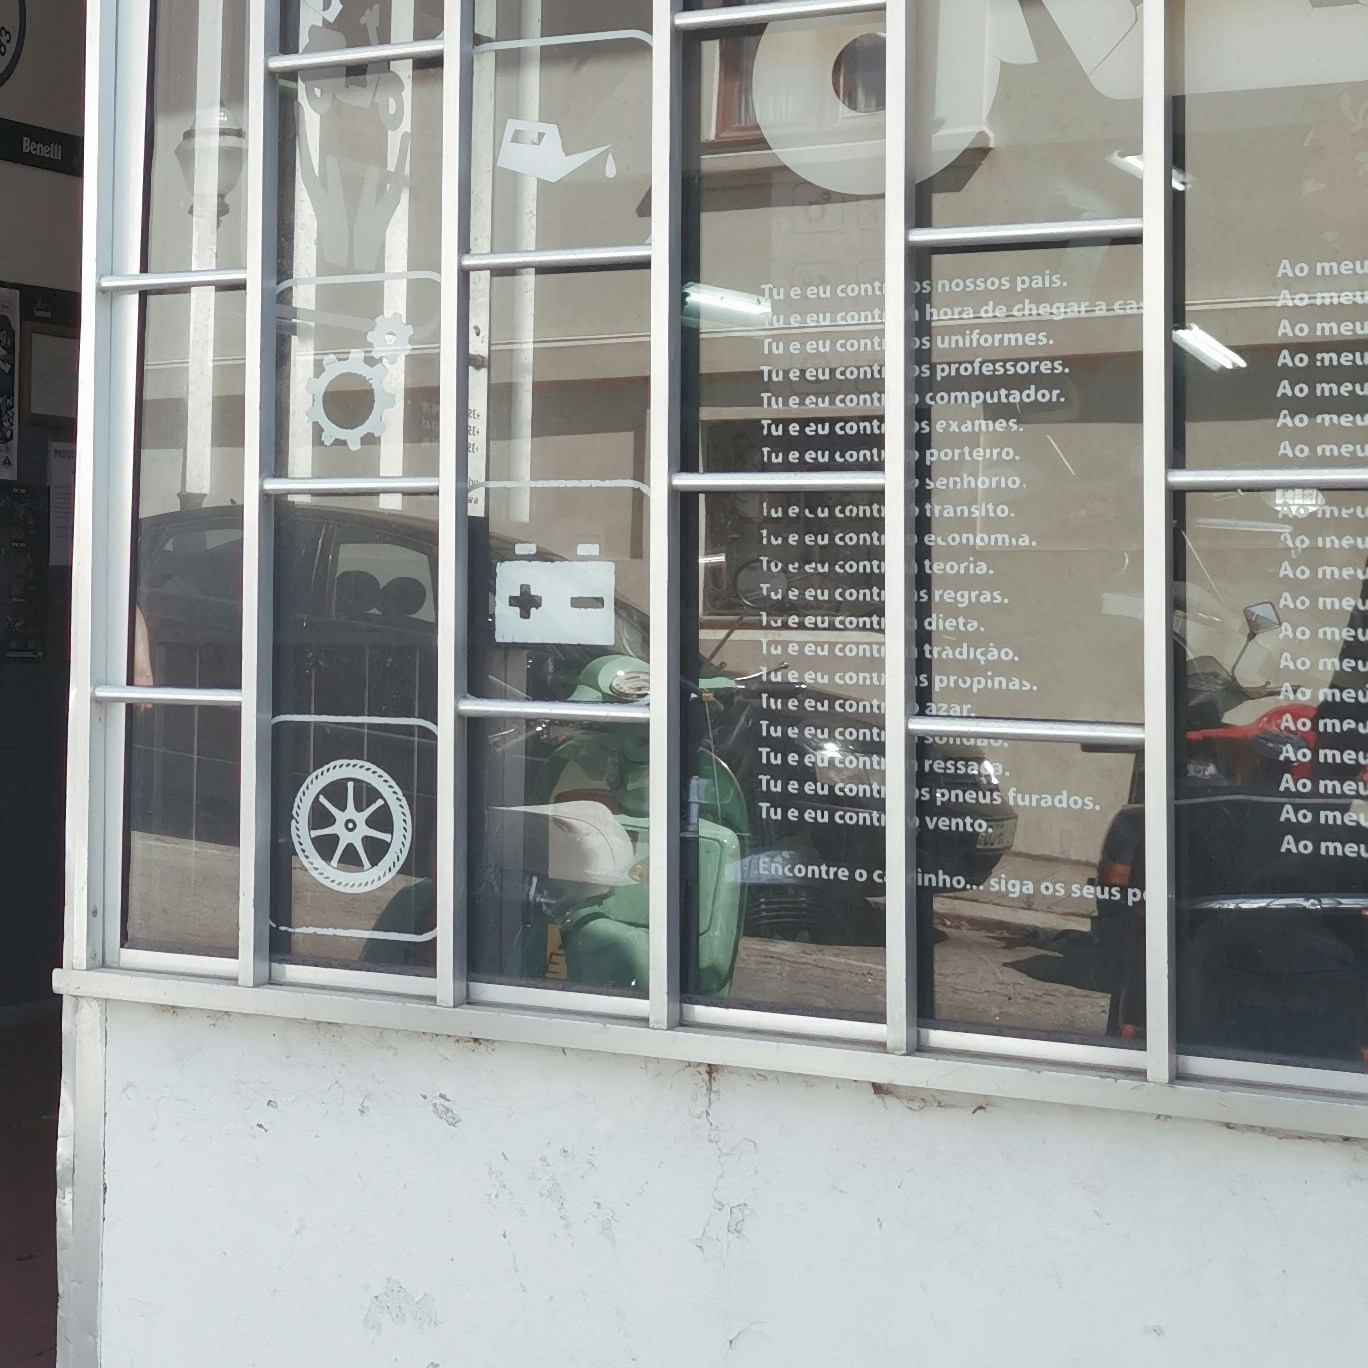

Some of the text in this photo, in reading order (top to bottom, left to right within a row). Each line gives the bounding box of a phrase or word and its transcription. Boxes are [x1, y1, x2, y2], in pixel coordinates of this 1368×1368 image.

[22, 135, 62, 161] Benelli
[1276, 259, 1309, 277] Ao
[761, 283, 783, 300] Tu
[790, 286, 801, 299] e
[807, 284, 830, 298] eu
[937, 275, 1010, 293] nossos
[1016, 270, 1068, 292] pais.
[929, 303, 974, 321] hora
[980, 301, 1006, 317] de
[1013, 299, 1089, 320] chegar
[1277, 319, 1309, 337] Ao
[763, 338, 783, 354] Tu
[789, 340, 800, 354] e
[806, 339, 830, 353] eu
[936, 330, 1054, 349] uniformes.
[1277, 349, 1309, 367] Ao
[760, 365, 783, 382] Tu
[789, 368, 800, 382] e
[805, 367, 830, 381] eu
[936, 360, 1070, 380] professores.
[760, 384, 1065, 408] Tu e eu computador.
[1276, 379, 1308, 398] Ao
[761, 418, 1024, 436] Tu e eu exames.
[762, 446, 1021, 466] Tu e eu porteiro.
[1278, 440, 1309, 458] Ao
[924, 557, 994, 575] teoria.
[760, 584, 1009, 608] Tu e eu regras.
[1278, 591, 1310, 609] Ao
[924, 613, 985, 632] dieta.
[1279, 622, 1310, 640] Ao
[788, 641, 799, 656] e
[804, 642, 829, 656] eu
[924, 642, 1019, 665] tradição.
[1279, 652, 1311, 671] Ao
[934, 672, 1038, 693] propinas.
[925, 702, 976, 717] azar.
[760, 721, 781, 738] Tu
[788, 724, 798, 738] e
[804, 725, 829, 739] eu
[759, 748, 781, 765] Tu
[787, 751, 798, 765] e
[804, 753, 829, 767] eu
[1280, 744, 1312, 762] Ao
[1279, 773, 1312, 792] Ao
[759, 775, 781, 792] Tu
[787, 779, 798, 793] e
[804, 780, 829, 795] eu
[936, 789, 1002, 805] pneus
[1008, 787, 1101, 811] furados.
[759, 802, 781, 820] Tu
[787, 807, 798, 821] e
[803, 809, 829, 823] eu
[925, 815, 993, 834] vento.
[1280, 804, 1312, 822] Ao
[1280, 834, 1313, 853] Ao
[759, 858, 849, 881] Encontre
[855, 869, 867, 882] o
[989, 874, 1033, 898] siga
[1040, 881, 1065, 896] os
[1071, 884, 1121, 901] seus
